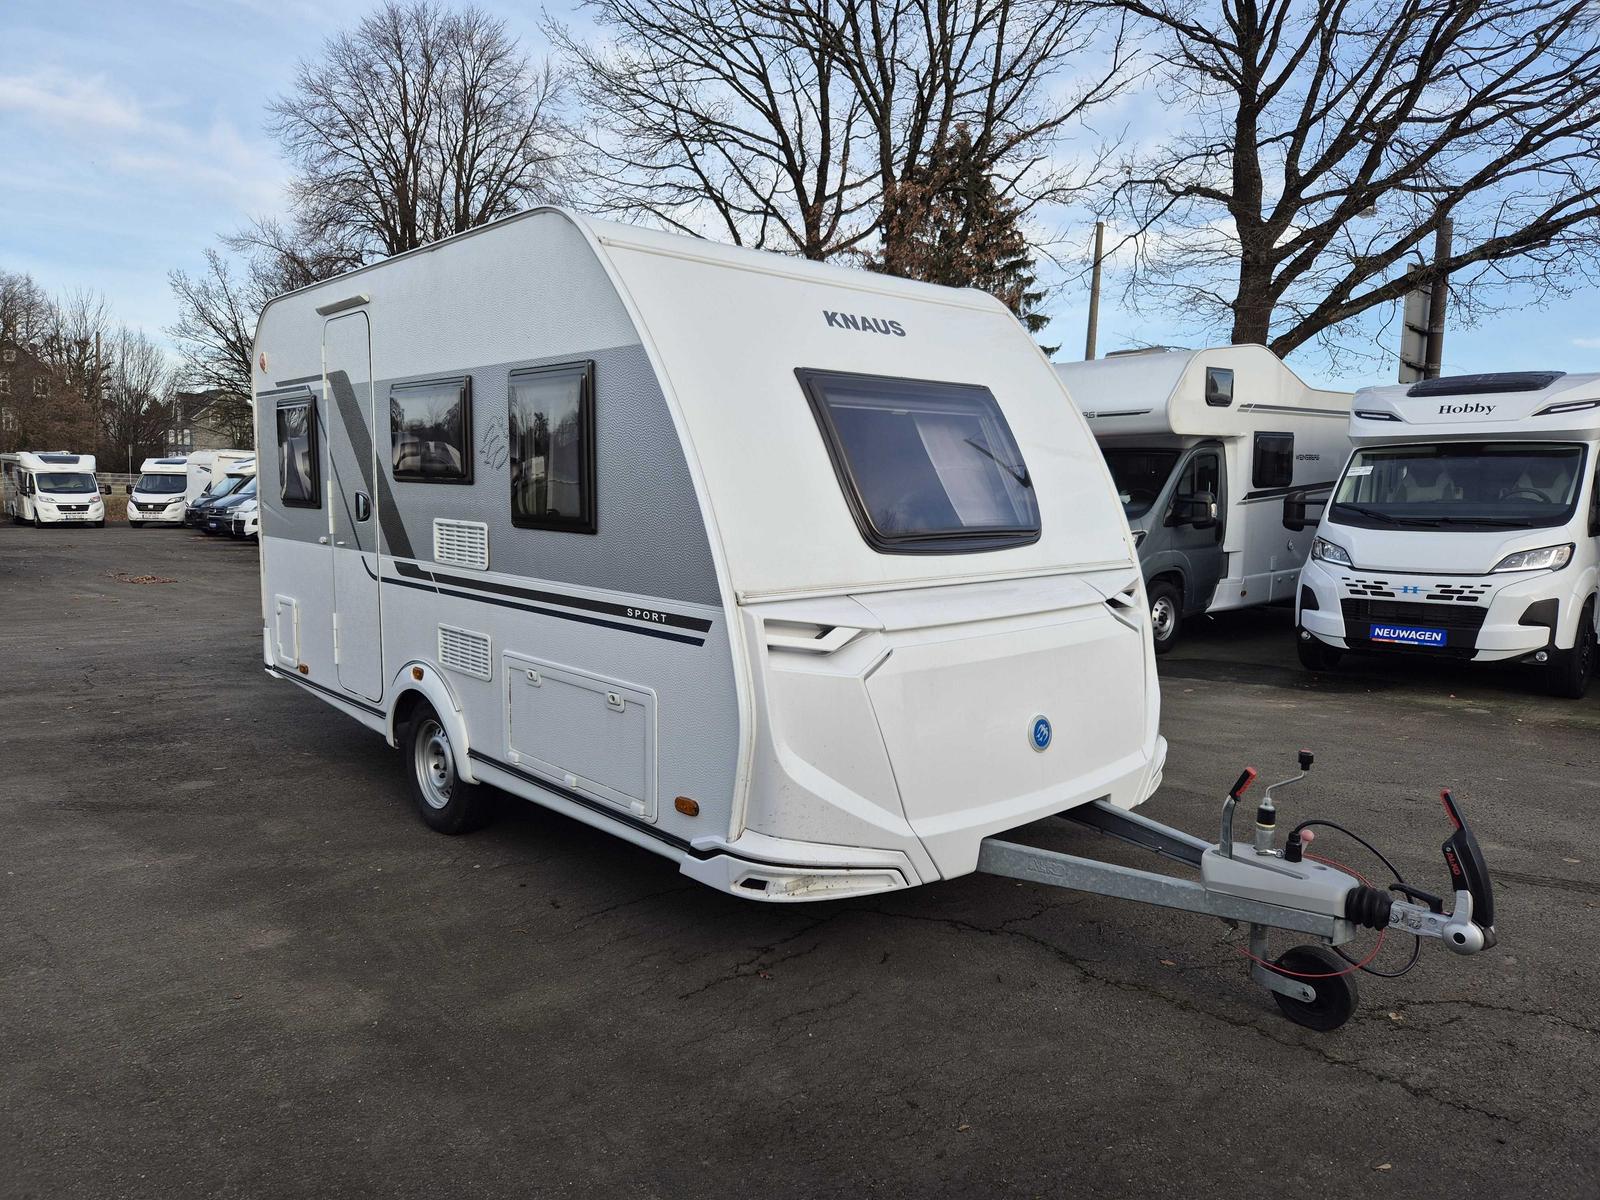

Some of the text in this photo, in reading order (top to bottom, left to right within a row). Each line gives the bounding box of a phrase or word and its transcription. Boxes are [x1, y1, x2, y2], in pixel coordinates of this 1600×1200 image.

[822, 310, 906, 337] KNAUS
[1439, 403, 1496, 415] Hobby
[627, 608, 667, 622] SPORT
[1375, 628, 1442, 641] NEUWAGEN
